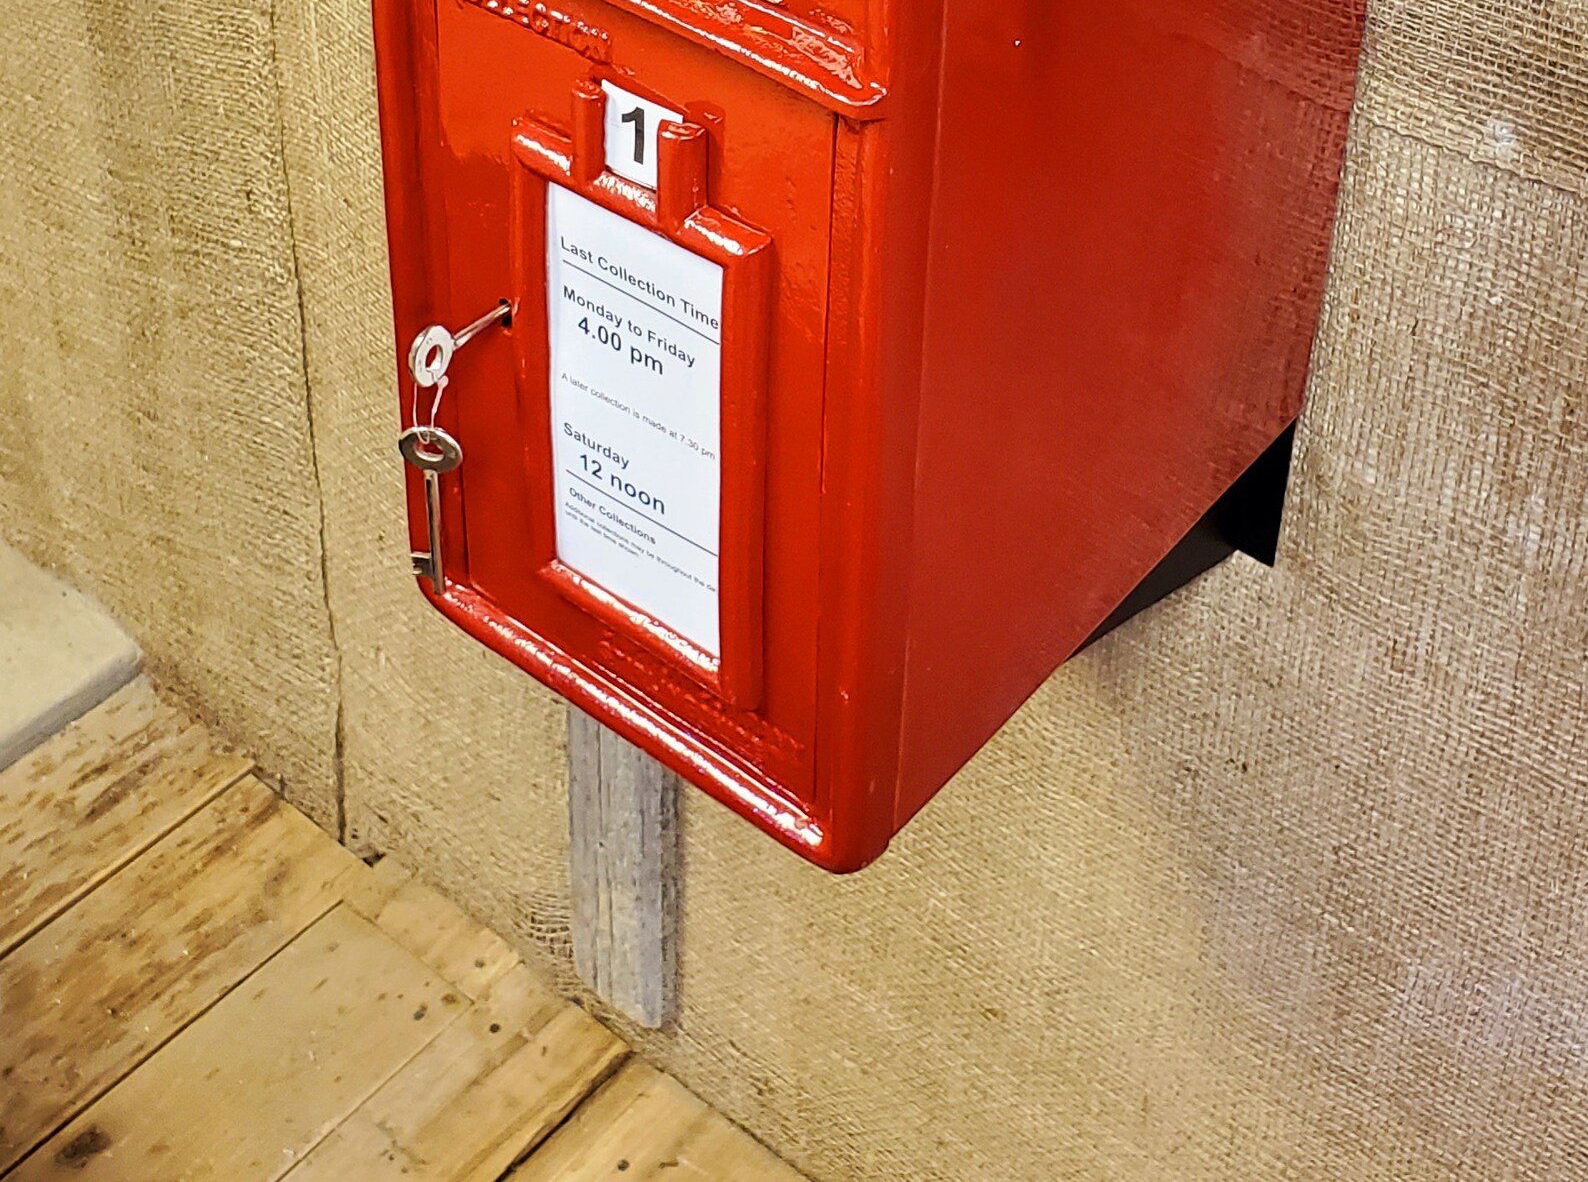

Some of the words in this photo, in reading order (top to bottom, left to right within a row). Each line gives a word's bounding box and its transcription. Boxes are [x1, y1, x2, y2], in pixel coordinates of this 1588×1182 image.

[621, 106, 645, 165] 1
[560, 236, 593, 264] Last
[597, 256, 676, 307] Collection
[680, 298, 719, 330] Time
[563, 285, 623, 327] Monday
[627, 320, 642, 336] to
[648, 330, 695, 368] Friday
[578, 316, 622, 352] 4.00
[630, 345, 663, 375] pm
[561, 372, 568, 382] A
[570, 376, 589, 391] later
[590, 387, 631, 416] collection
[632, 408, 640, 419] is
[642, 415, 667, 434] made
[669, 428, 678, 440] at
[680, 434, 699, 451] 7.30
[701, 448, 716, 460] pm
[563, 422, 630, 470] Saturday
[579, 454, 603, 480] 12
[610, 473, 666, 515] noon
[569, 487, 596, 510] Other
[599, 505, 657, 545] Collections
